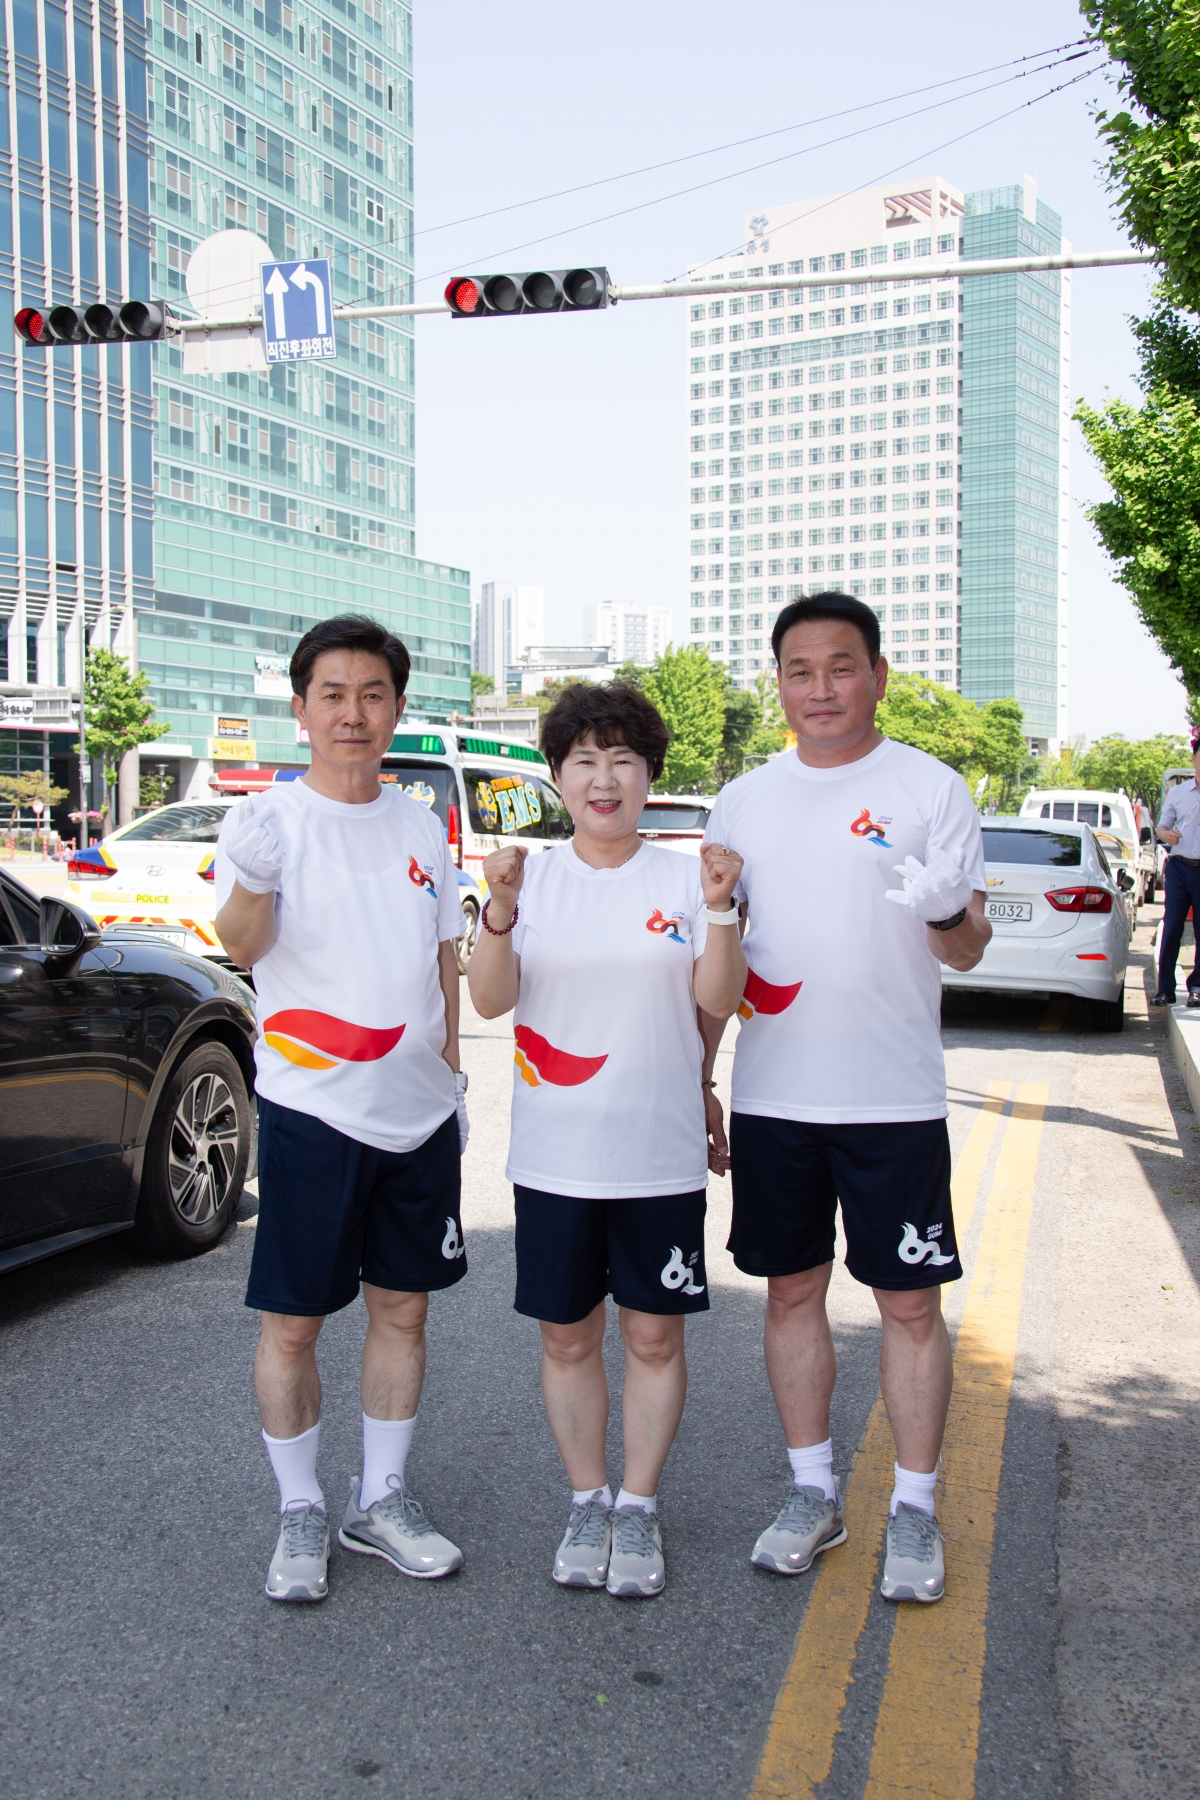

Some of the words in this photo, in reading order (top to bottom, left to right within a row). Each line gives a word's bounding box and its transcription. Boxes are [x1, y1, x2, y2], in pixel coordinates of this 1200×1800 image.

[267, 336, 334, 360] 직진후좌회전
[494, 781, 541, 834] EMS
[136, 894, 170, 904] POLICE
[989, 903, 1023, 918] 8032
[926, 1222, 943, 1234] 2024
